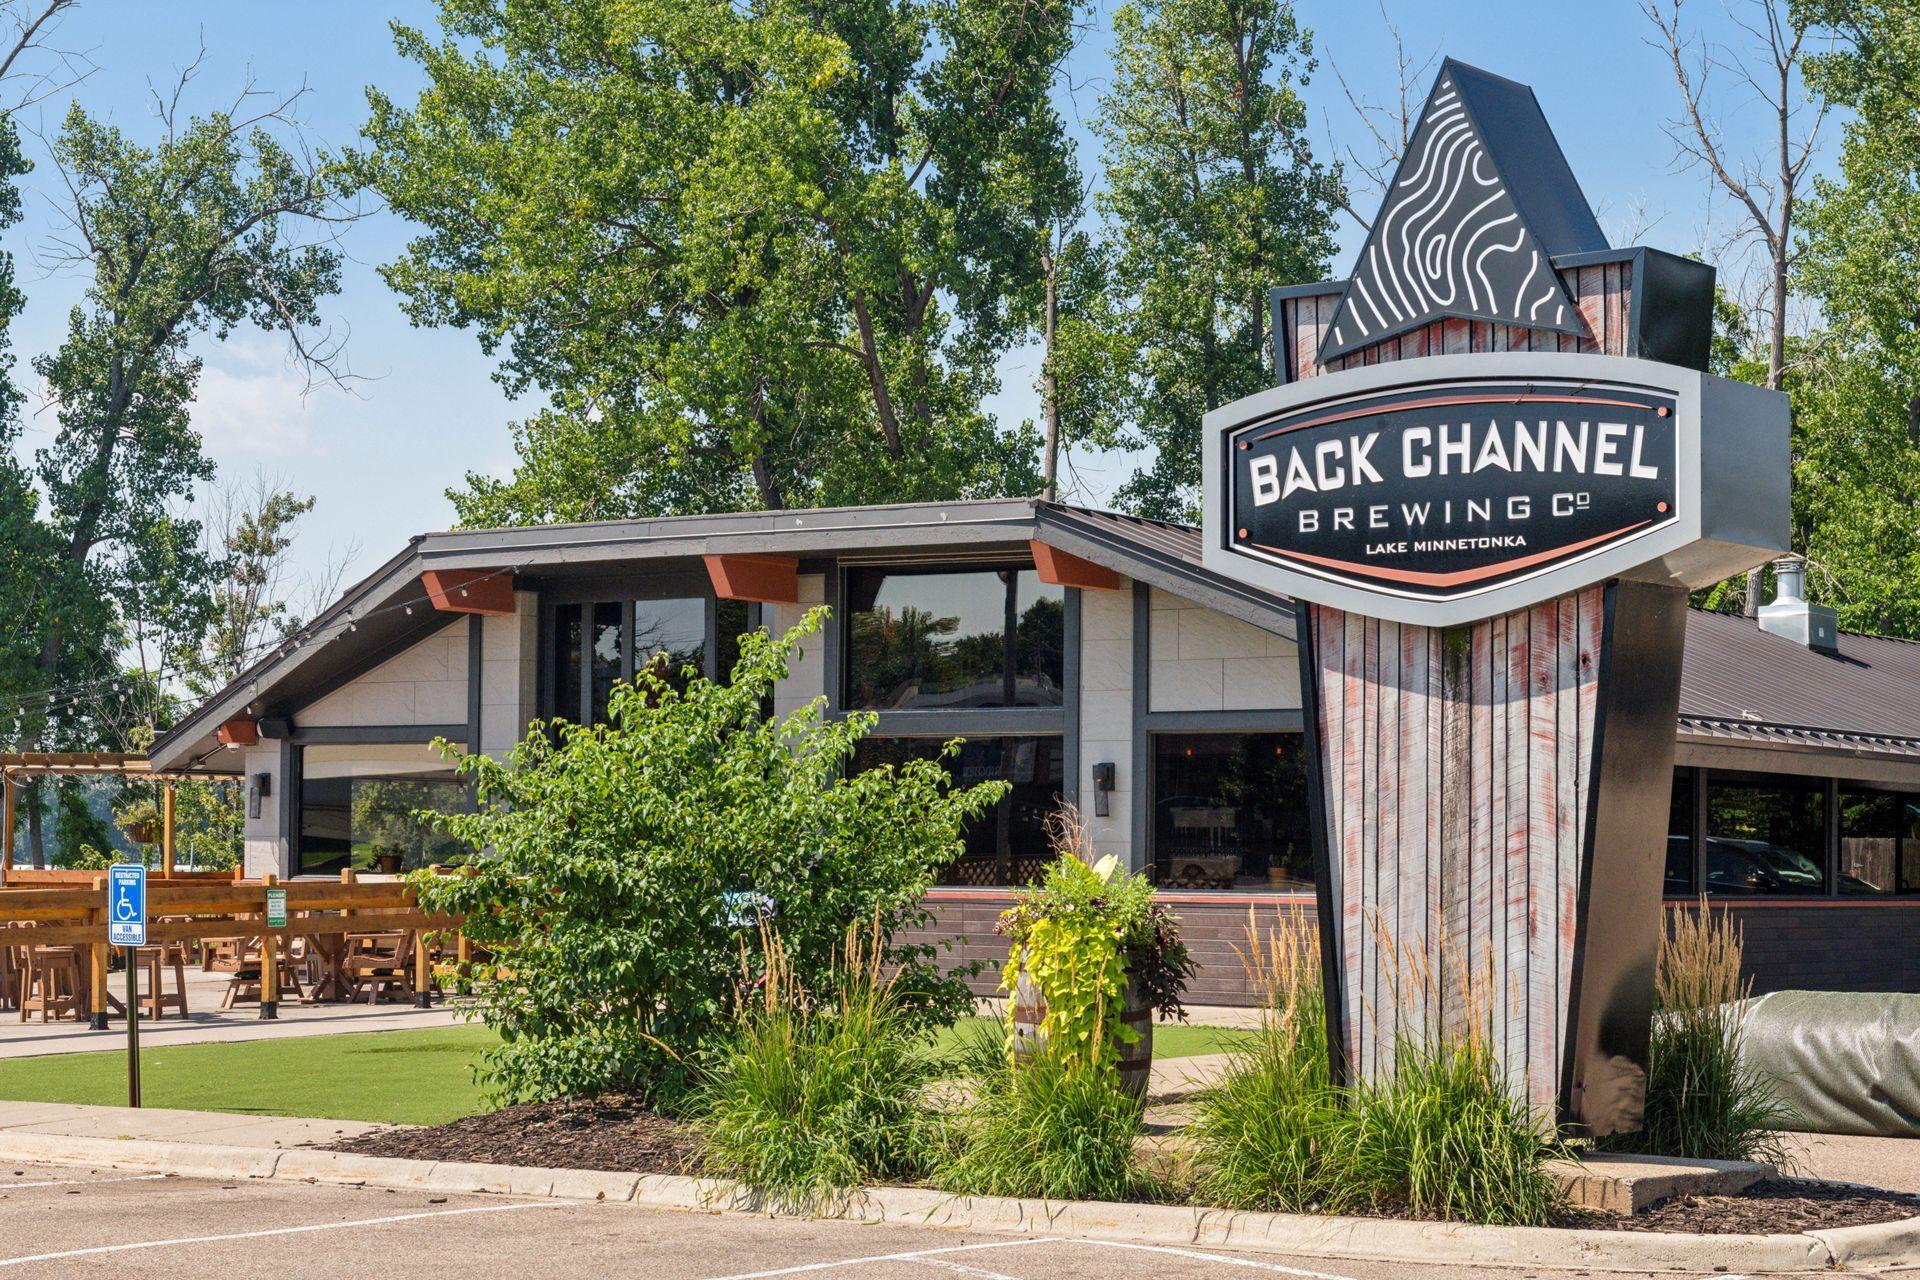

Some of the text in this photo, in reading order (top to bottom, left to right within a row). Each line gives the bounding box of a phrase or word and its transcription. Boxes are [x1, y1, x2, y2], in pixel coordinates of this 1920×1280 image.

[1249, 419, 1659, 507] BACK CHANNEL
[1299, 498, 1530, 532] BREWING
[1366, 535, 1527, 554] LAKE MINNETONKA
[113, 933, 142, 941] ACCESSIBLE
